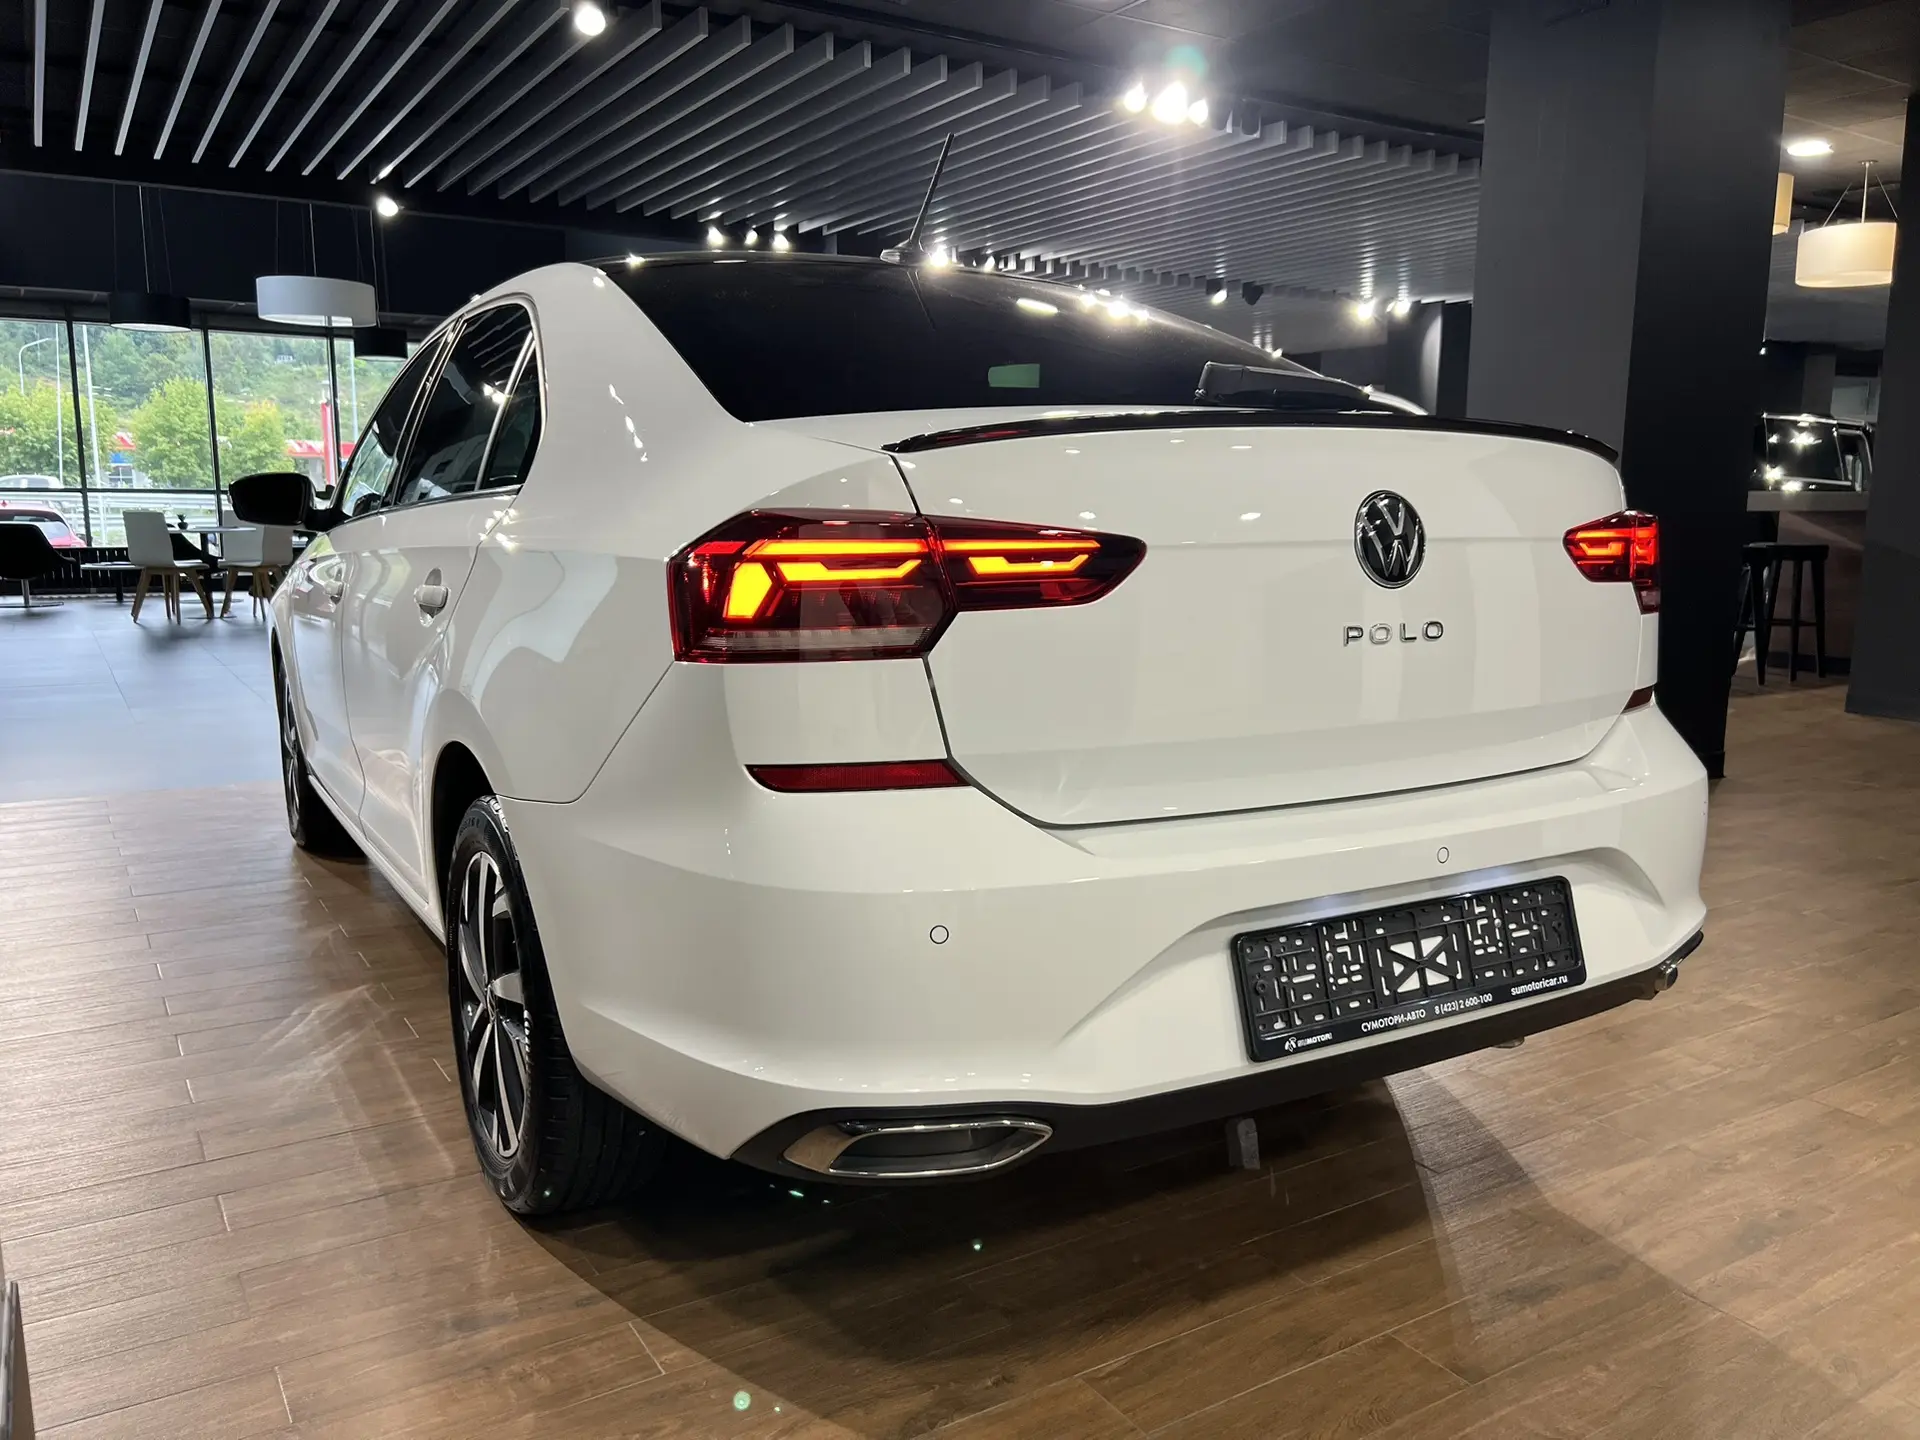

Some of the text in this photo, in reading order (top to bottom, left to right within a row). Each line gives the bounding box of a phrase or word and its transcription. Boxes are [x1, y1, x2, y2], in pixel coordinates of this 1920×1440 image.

[1343, 621, 1444, 647] POLO
[1510, 975, 1568, 996] sumotoricar.ru
[1434, 993, 1493, 1015] 8 (423) 2 600-100
[1361, 1009, 1426, 1032] СУМОТОРИ-АВТО
